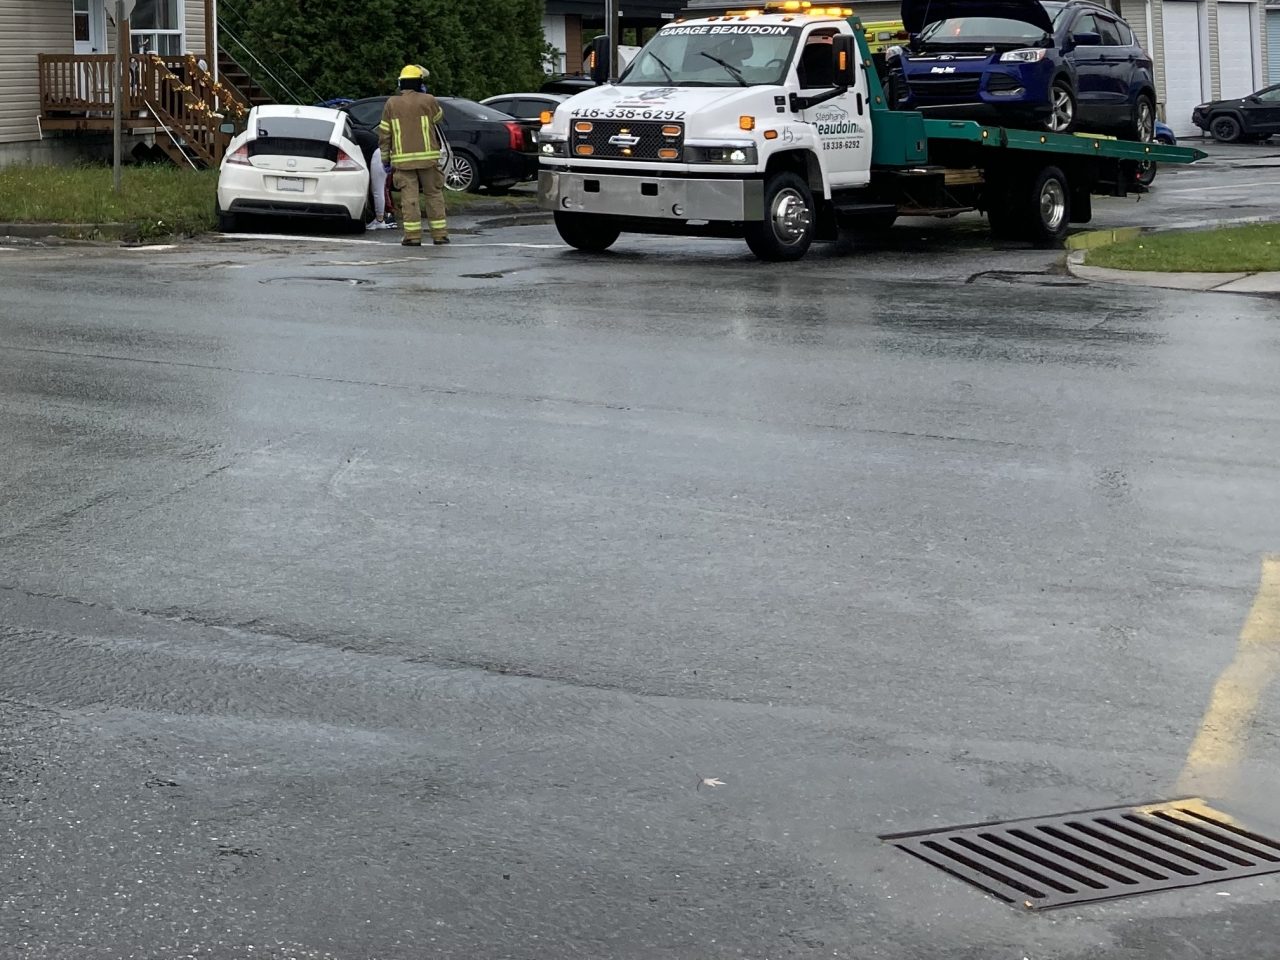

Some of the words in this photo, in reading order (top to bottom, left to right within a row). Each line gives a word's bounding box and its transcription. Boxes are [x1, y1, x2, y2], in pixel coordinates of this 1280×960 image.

[660, 26, 710, 36] GARAGE
[709, 26, 789, 35] BEAUDOIN
[571, 108, 686, 120] 418-338-6292
[831, 140, 860, 150] 338-6292
